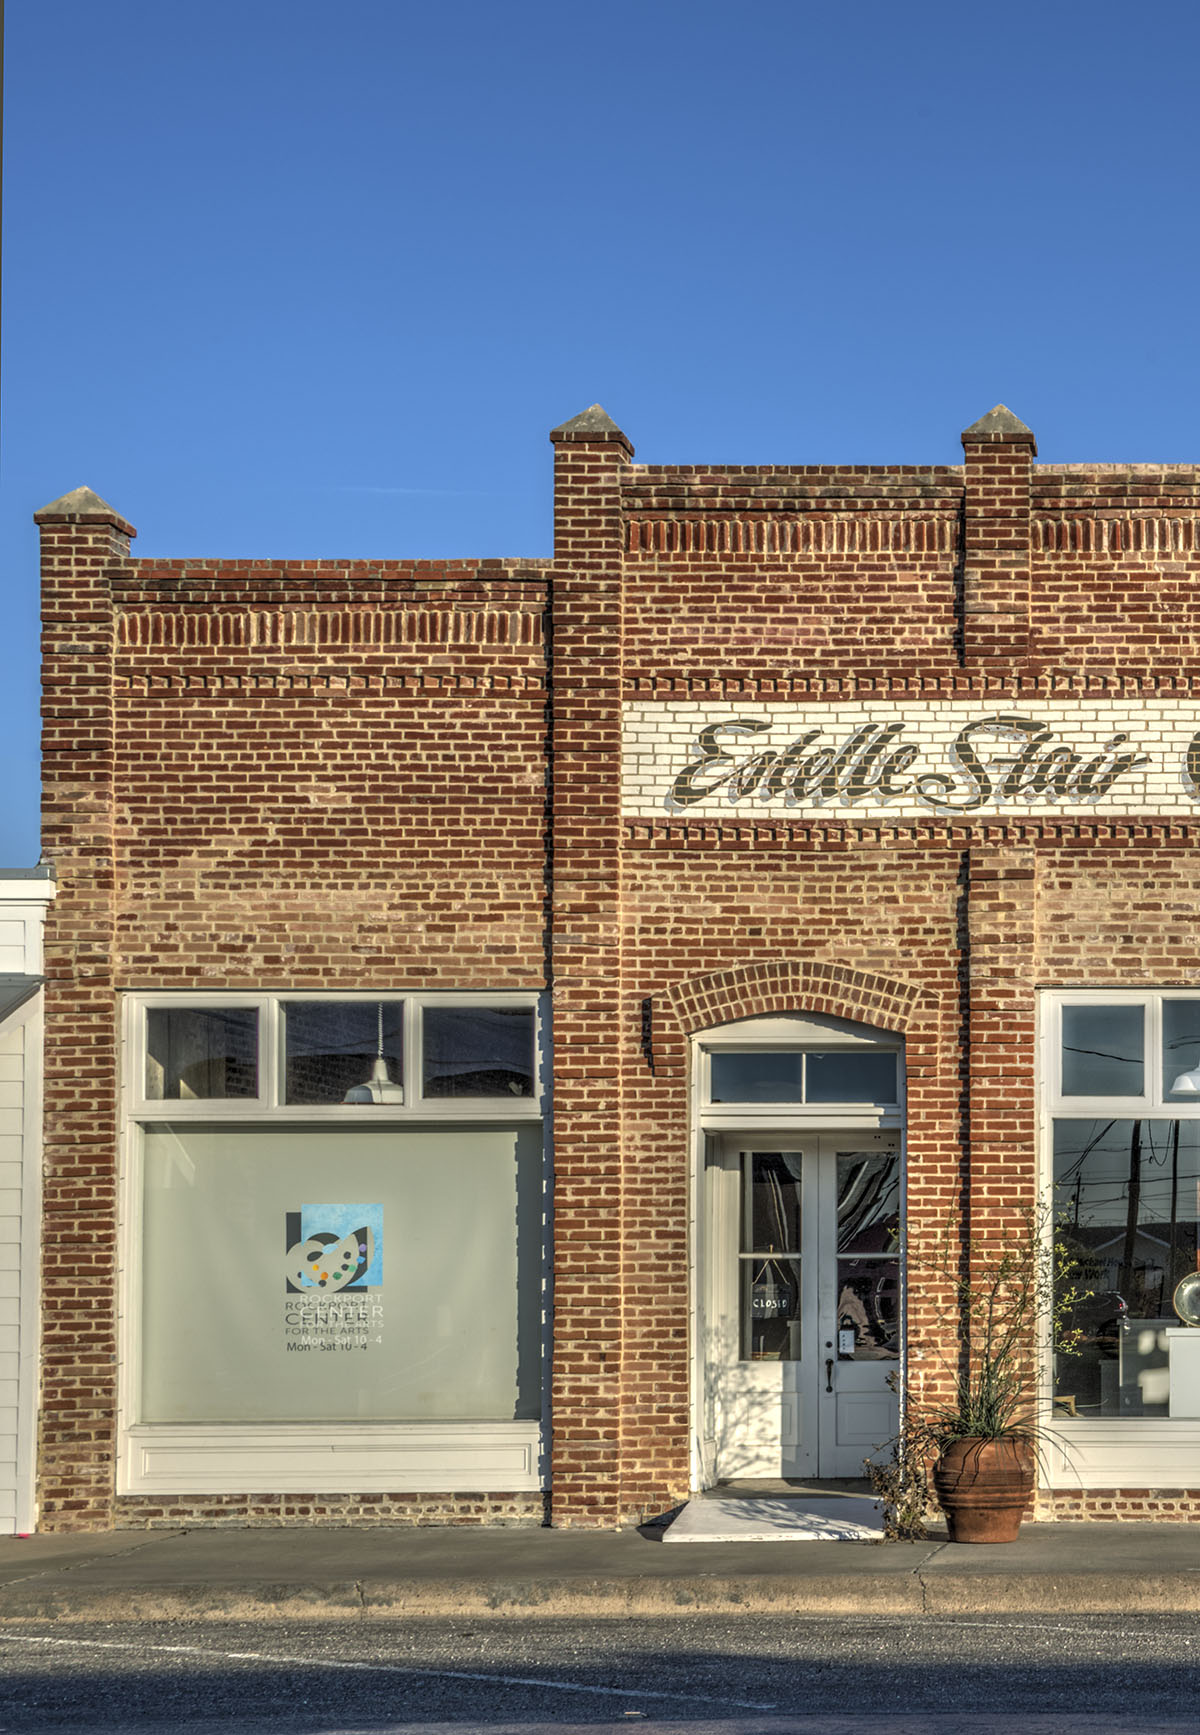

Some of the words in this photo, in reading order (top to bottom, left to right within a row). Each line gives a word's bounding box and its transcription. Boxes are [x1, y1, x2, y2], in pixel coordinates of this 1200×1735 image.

[664, 718, 920, 813] Estelle
[914, 715, 1153, 814] Stair
[300, 1294, 383, 1303] ROCKPORT
[300, 1306, 384, 1317] CENTER
[355, 1320, 384, 1328] ARTS
[301, 1335, 326, 1344] Mon
[334, 1335, 351, 1344] Sat
[376, 1335, 382, 1344] 4
